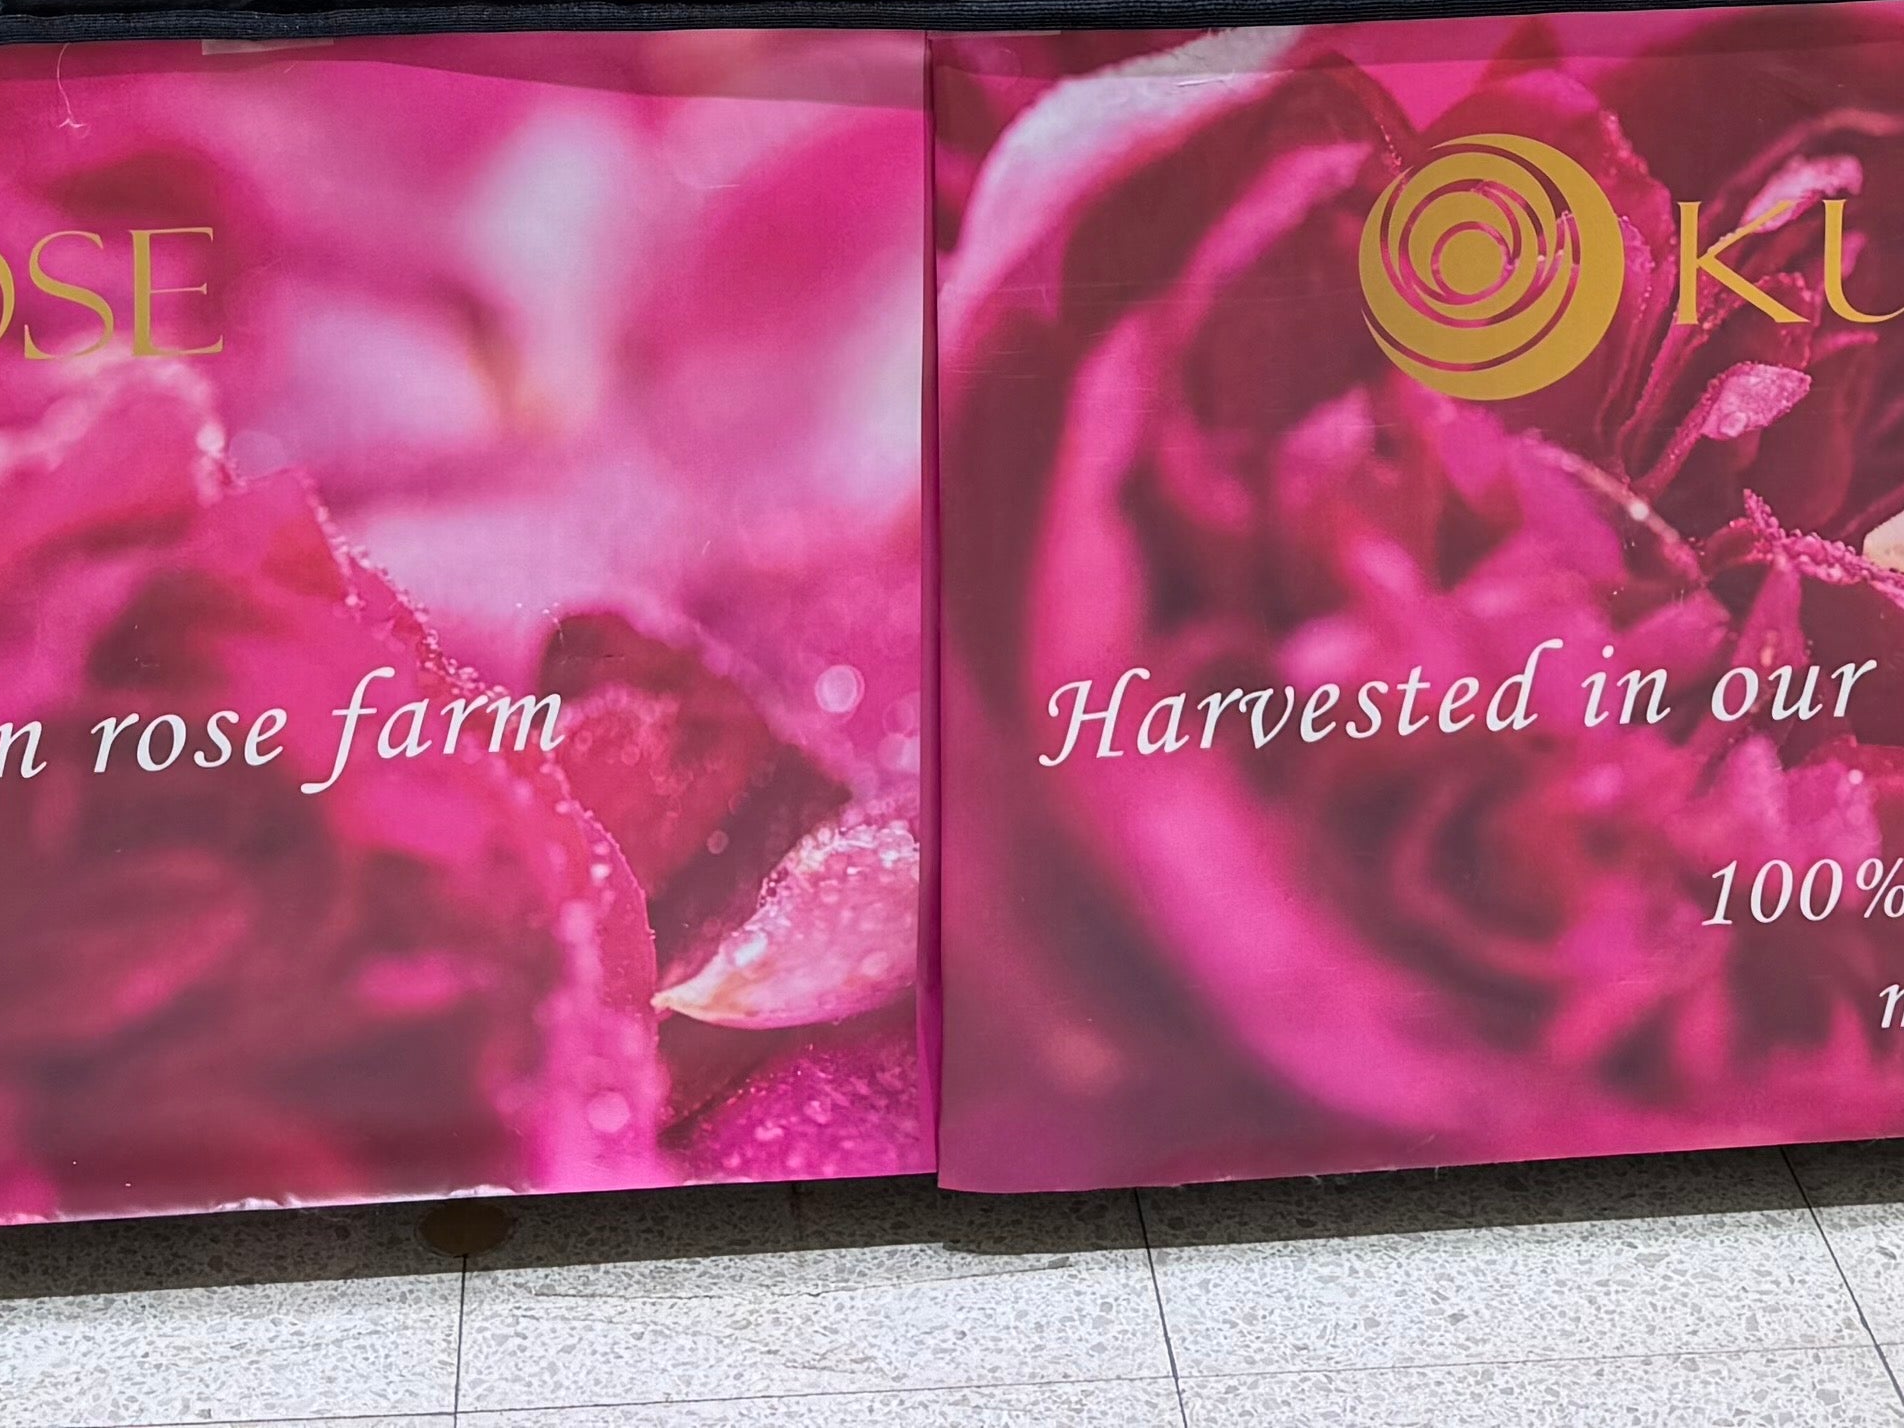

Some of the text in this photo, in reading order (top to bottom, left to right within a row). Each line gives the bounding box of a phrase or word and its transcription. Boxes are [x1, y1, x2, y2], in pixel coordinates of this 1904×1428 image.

[90, 700, 289, 776] rose
[300, 666, 566, 795] farm
[1038, 638, 1564, 768] Harvested
[1583, 644, 1672, 728] in
[1710, 657, 1878, 723] our
